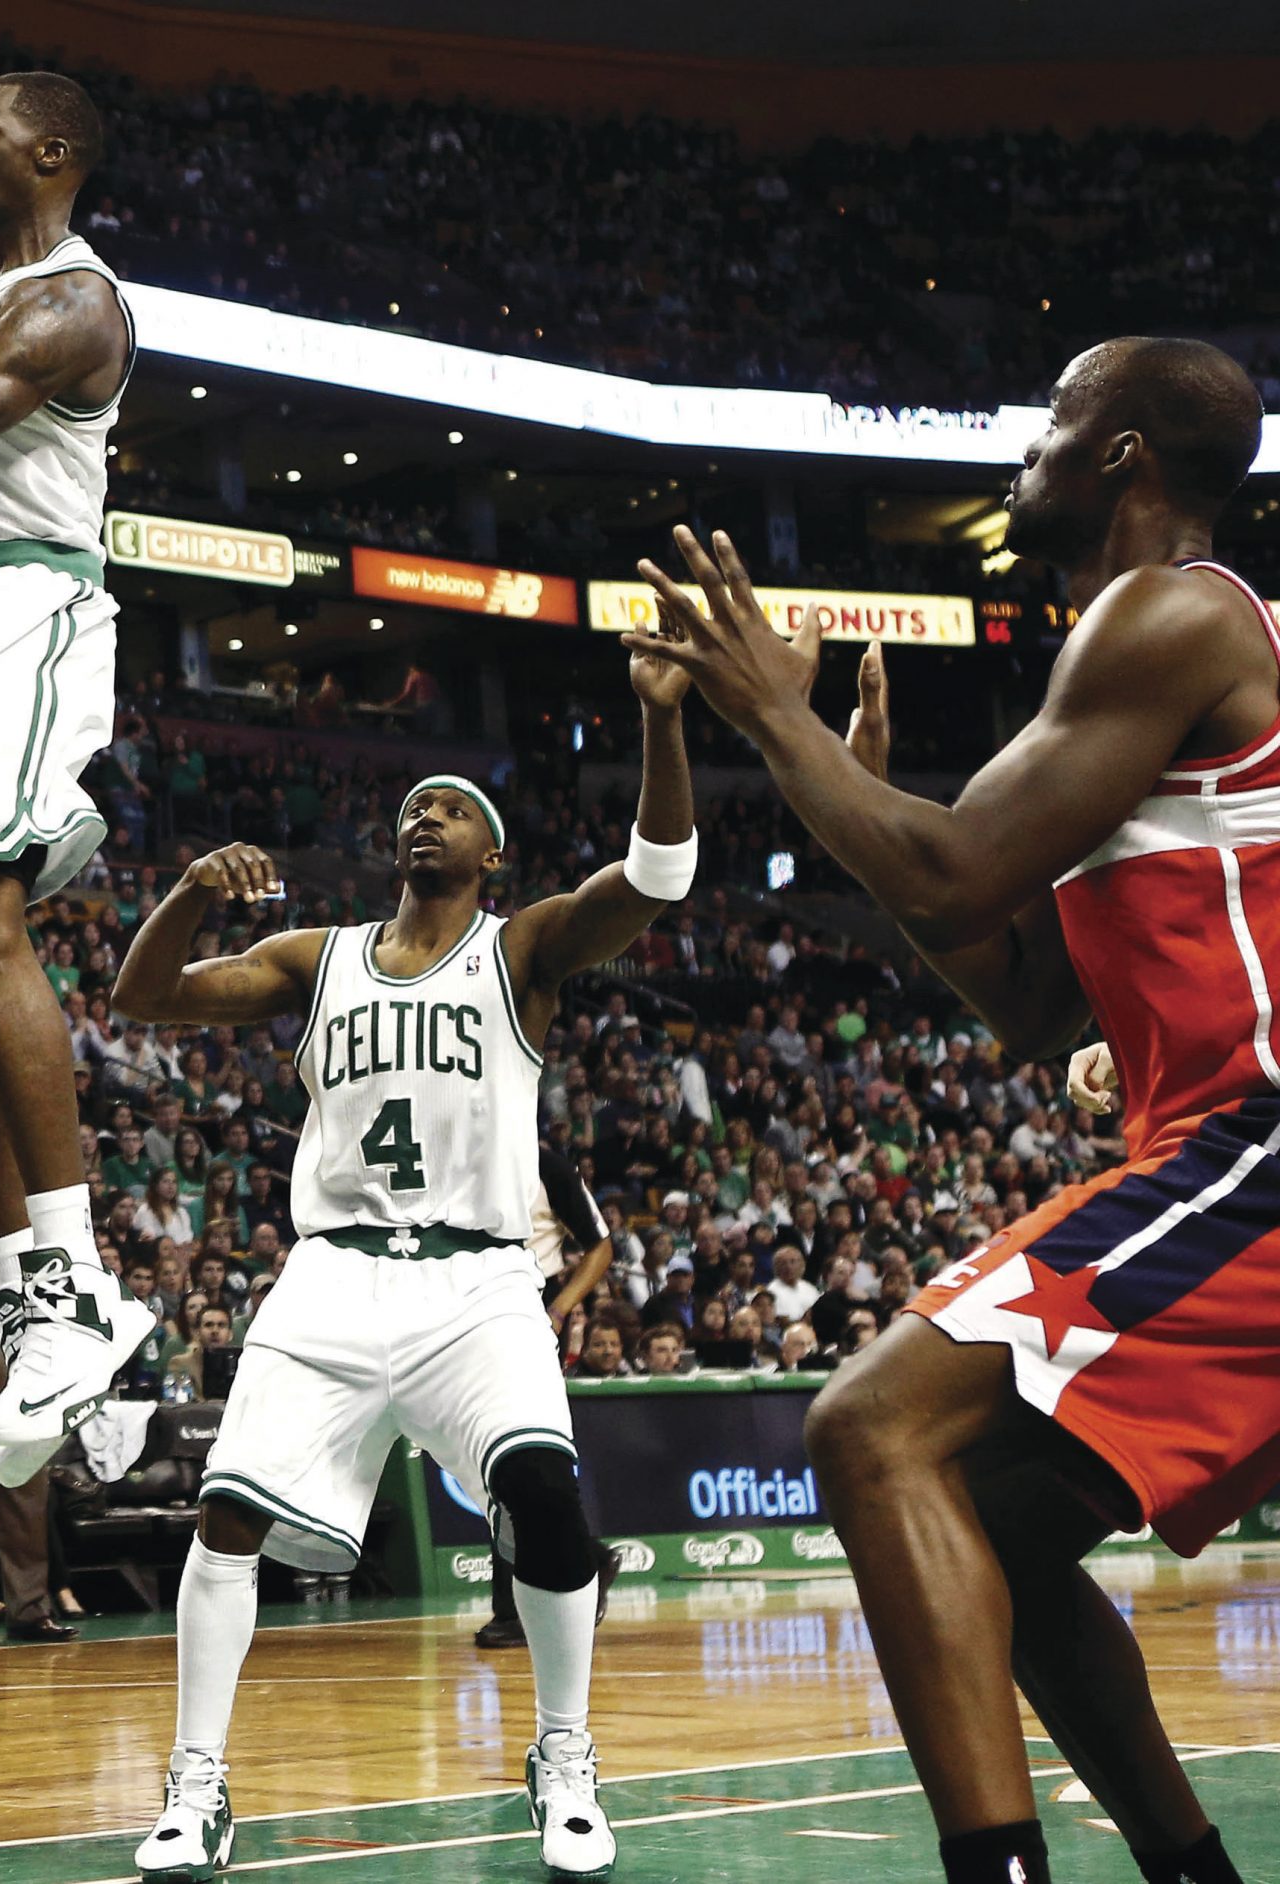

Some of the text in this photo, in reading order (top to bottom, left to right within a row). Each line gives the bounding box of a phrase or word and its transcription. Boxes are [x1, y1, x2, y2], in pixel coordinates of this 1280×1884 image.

[149, 529, 285, 574] CHIPOTLE
[387, 567, 421, 588] new
[422, 570, 486, 599] balance
[787, 604, 928, 636] DONUTS
[322, 1000, 483, 1091] CELTICS
[359, 1097, 428, 1192] 4
[688, 1466, 818, 1519] Official
